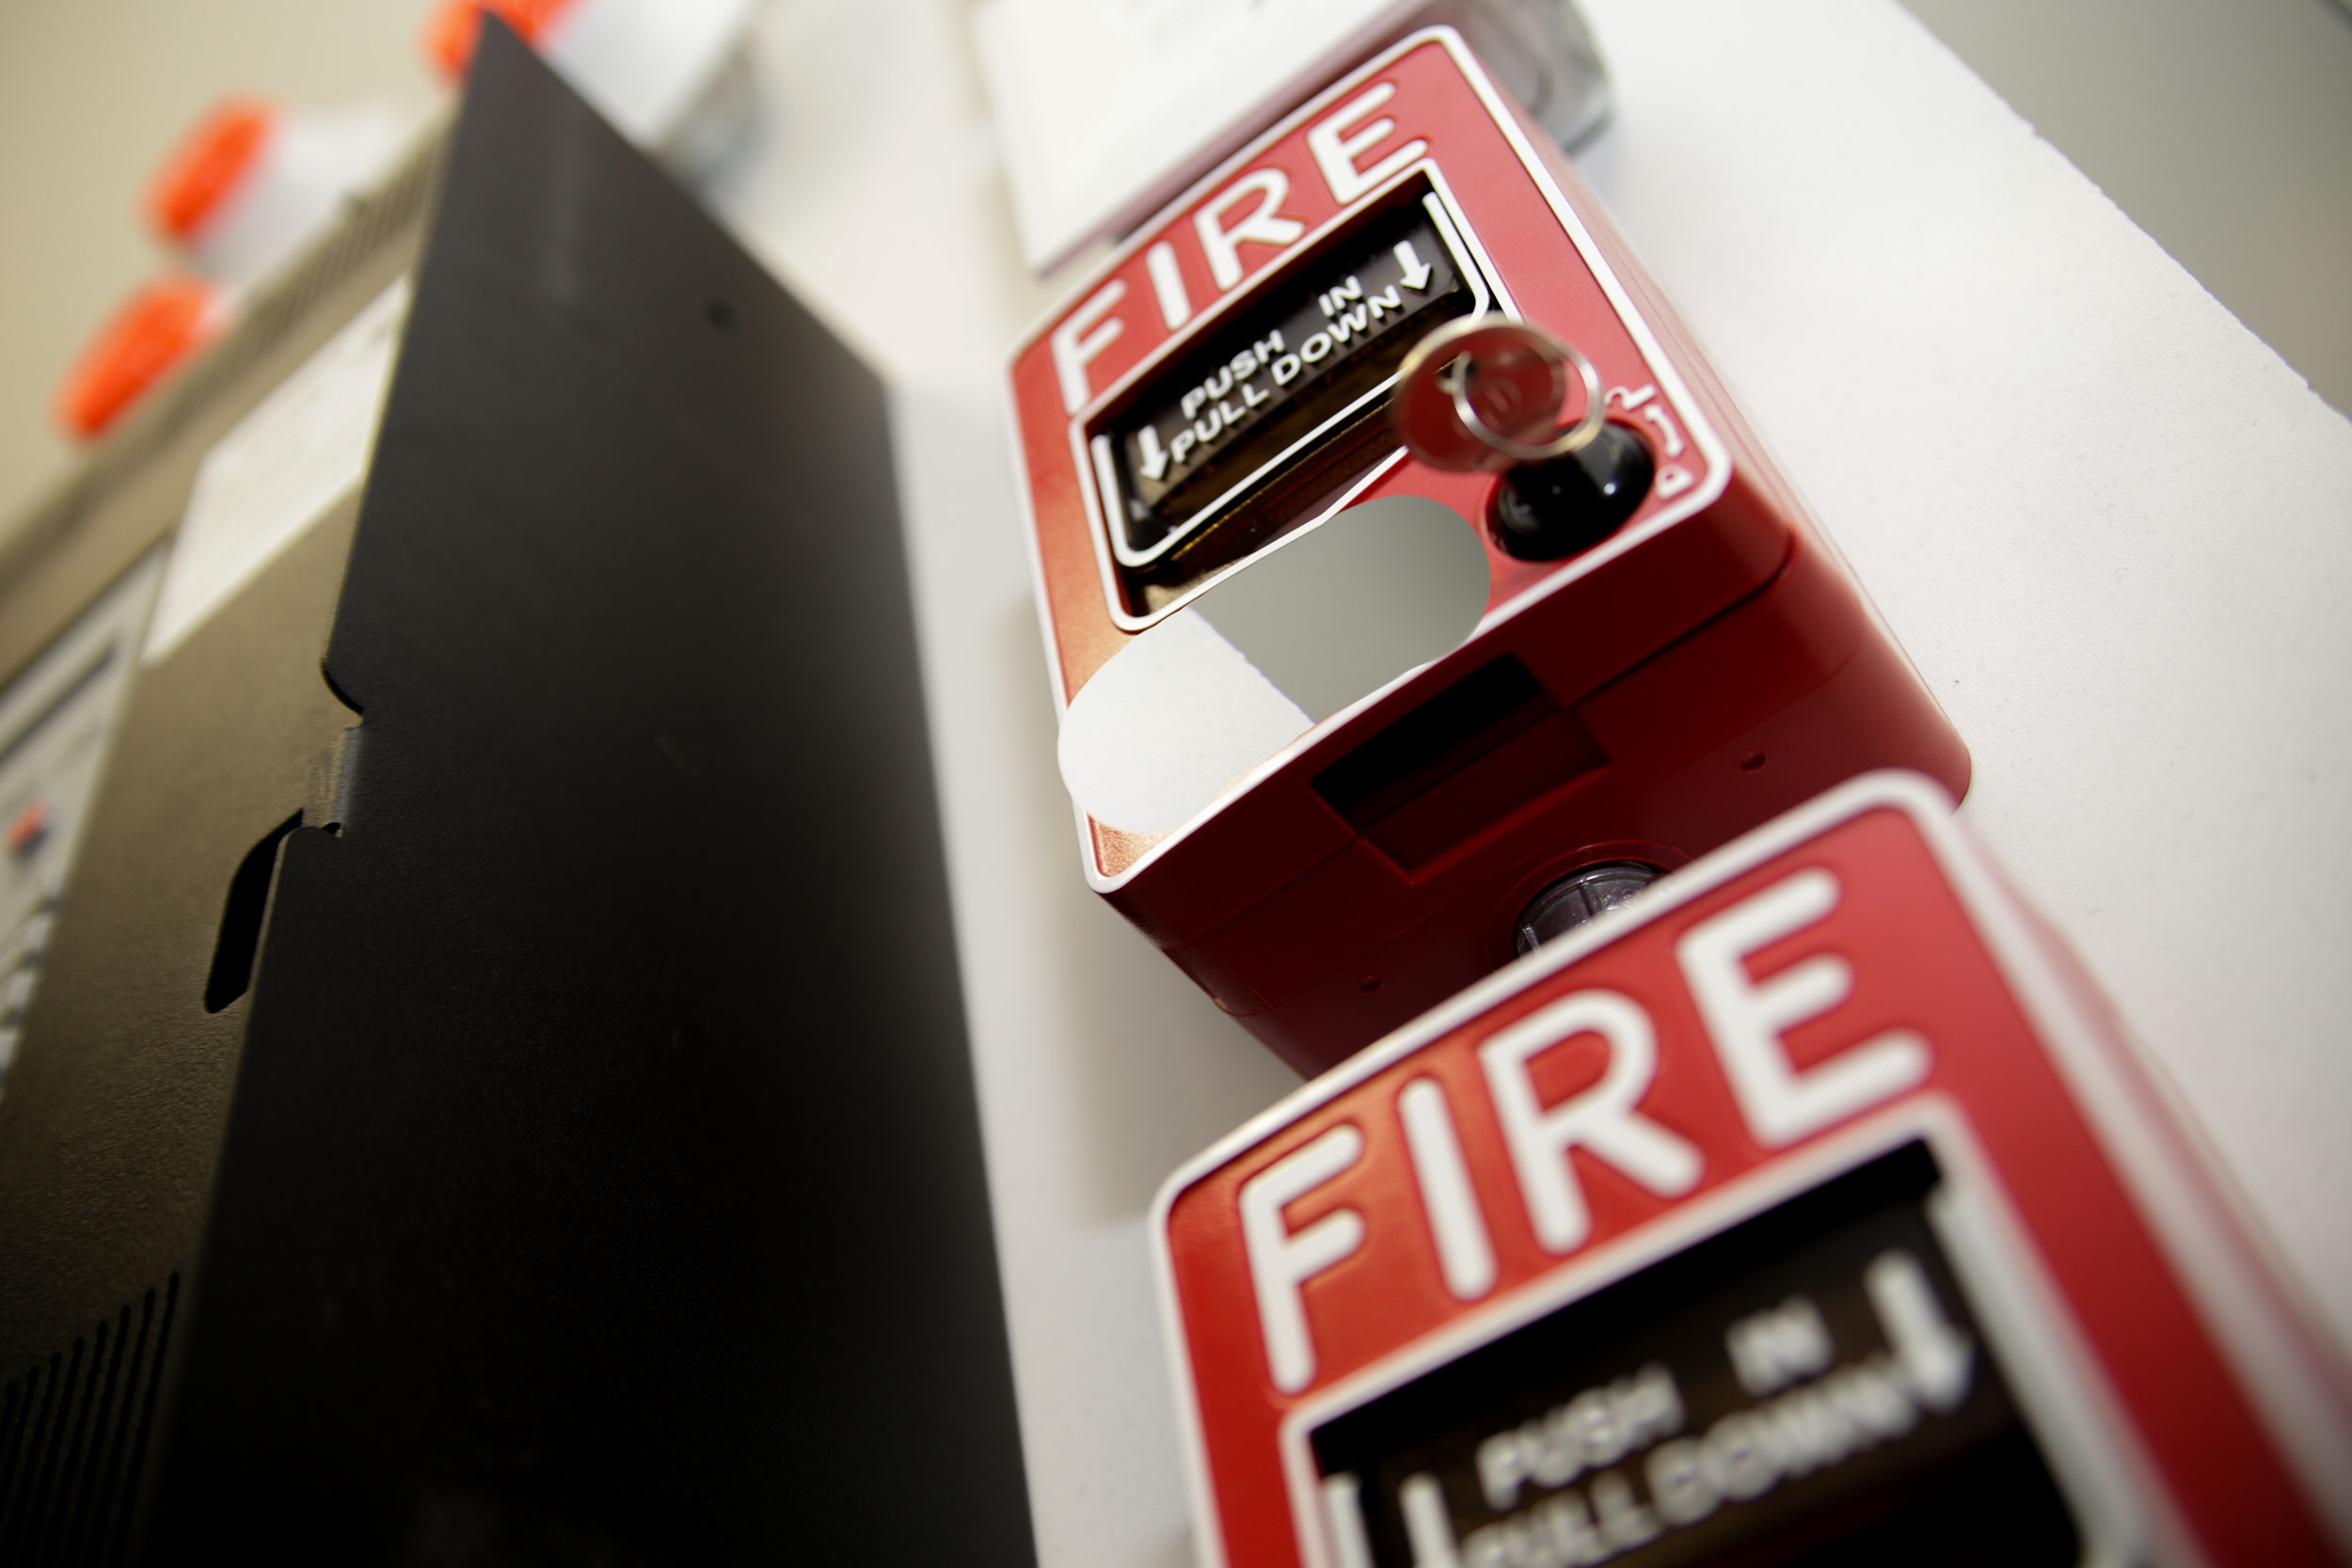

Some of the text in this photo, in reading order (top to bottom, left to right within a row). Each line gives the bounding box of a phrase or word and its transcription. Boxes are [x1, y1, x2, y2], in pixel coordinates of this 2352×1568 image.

[1051, 83, 1429, 414] FIRE
[1170, 285, 1402, 463] PULL DOWN
[1181, 276, 1363, 420] PUSH IN
[1238, 867, 1932, 1395] FIRE
[1476, 1298, 1831, 1509] PUSH IN
[1645, 1353, 1919, 1526] DOWN
